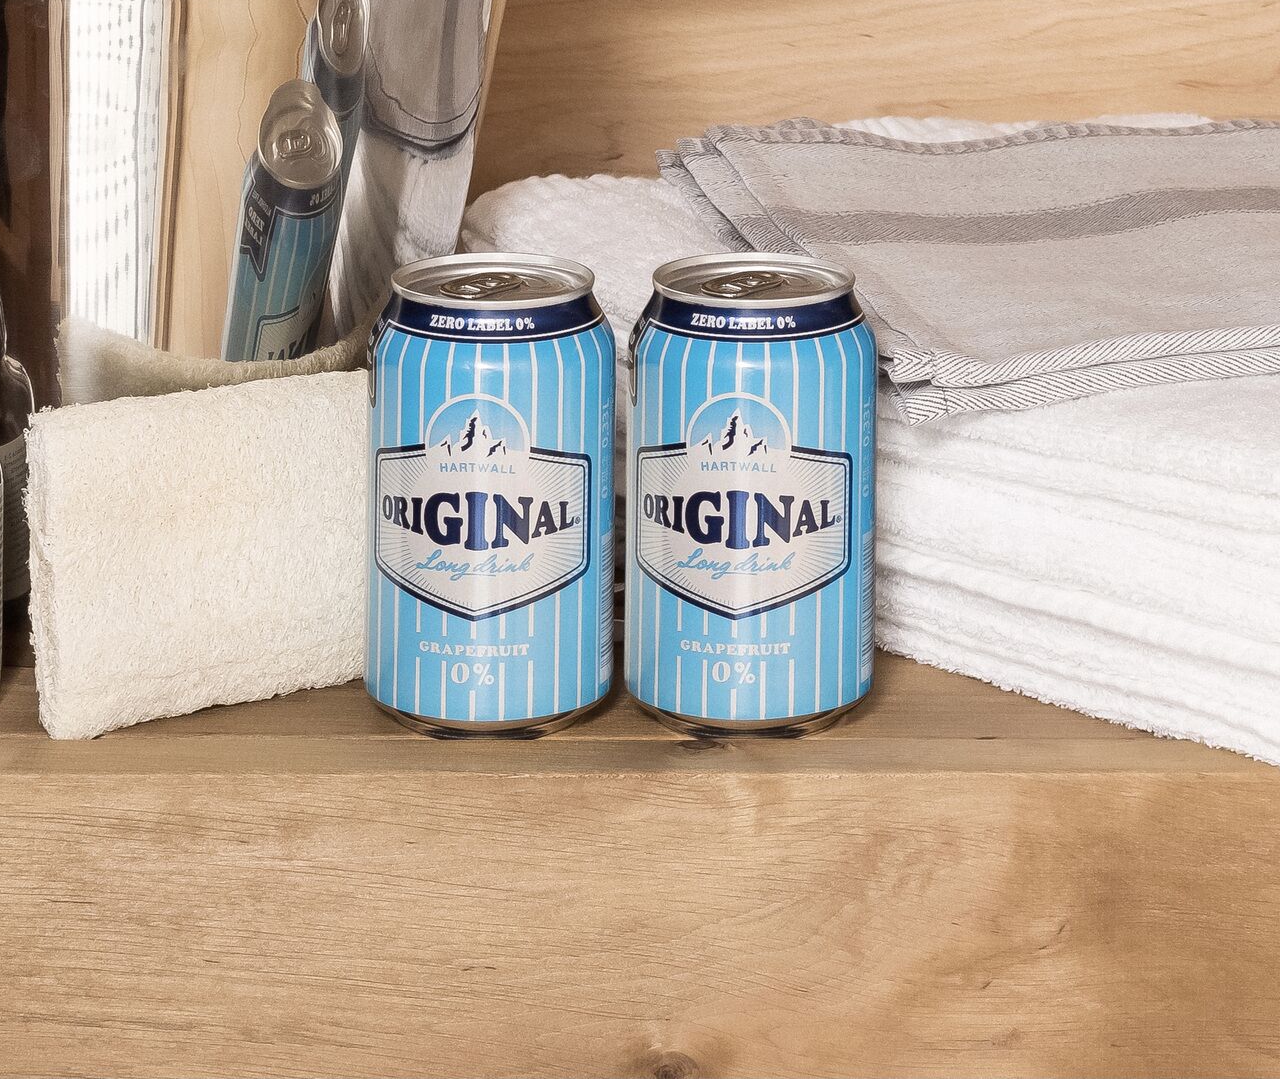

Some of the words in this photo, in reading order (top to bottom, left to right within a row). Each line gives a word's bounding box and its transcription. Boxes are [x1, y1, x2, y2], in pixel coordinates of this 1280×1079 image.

[429, 314, 464, 329] ZERO
[467, 318, 513, 331] LABEL
[516, 317, 535, 330] 0%
[690, 313, 726, 329] ZERO
[728, 317, 774, 330] LABEL
[777, 316, 796, 329] 0%
[439, 462, 516, 474] HARTWALL
[701, 461, 777, 473] HARTWALL
[416, 549, 470, 581] Long
[473, 553, 535, 574] drink
[677, 548, 732, 580] Long
[734, 552, 796, 573] drink
[420, 640, 529, 657] GRAPEFRUIT
[680, 639, 791, 656] GRAPEFRUIT
[451, 662, 495, 686] 0%
[712, 661, 756, 684] 0%
